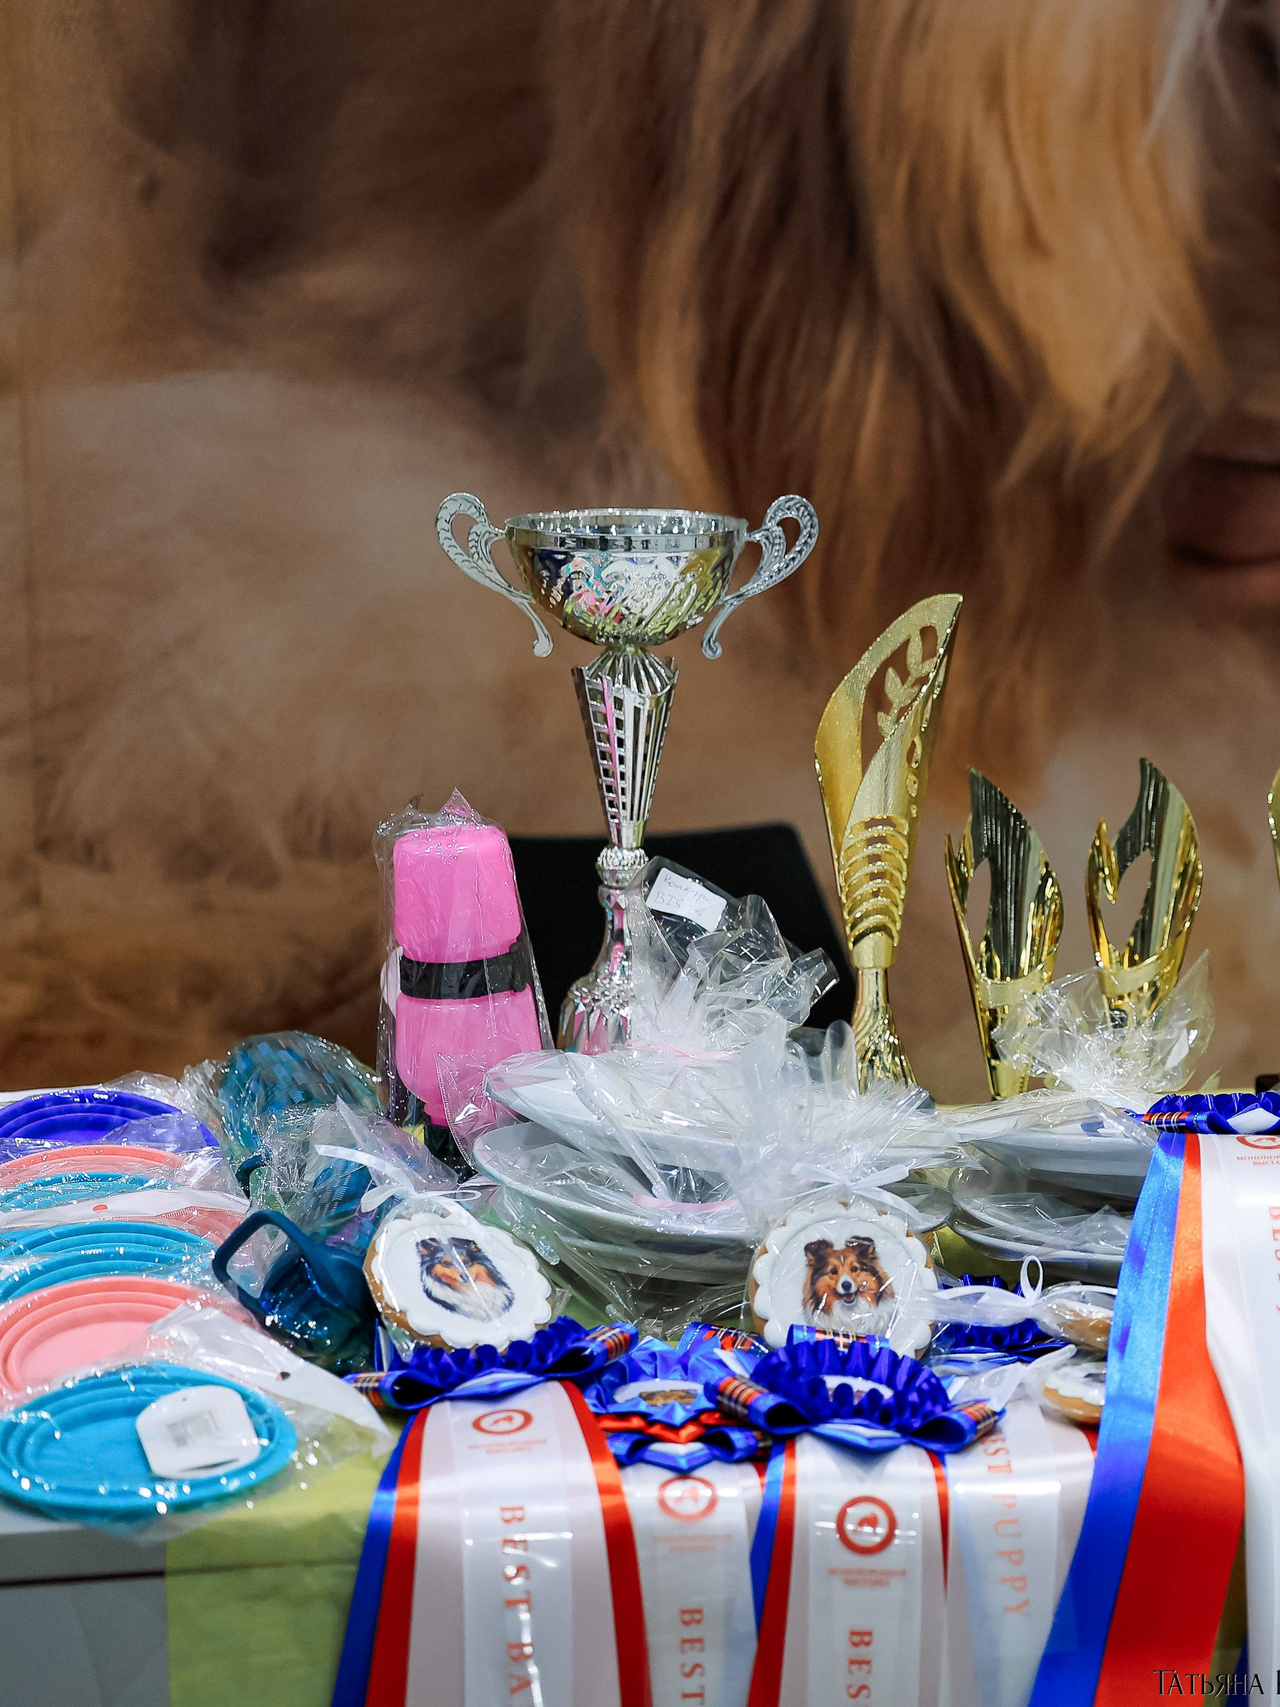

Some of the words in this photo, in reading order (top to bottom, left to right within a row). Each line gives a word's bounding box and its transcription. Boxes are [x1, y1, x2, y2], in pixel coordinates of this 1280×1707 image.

[499, 1504, 533, 1614] BEST
[992, 1493, 1031, 1619] PUPPY
[679, 1608, 706, 1706] BEST
